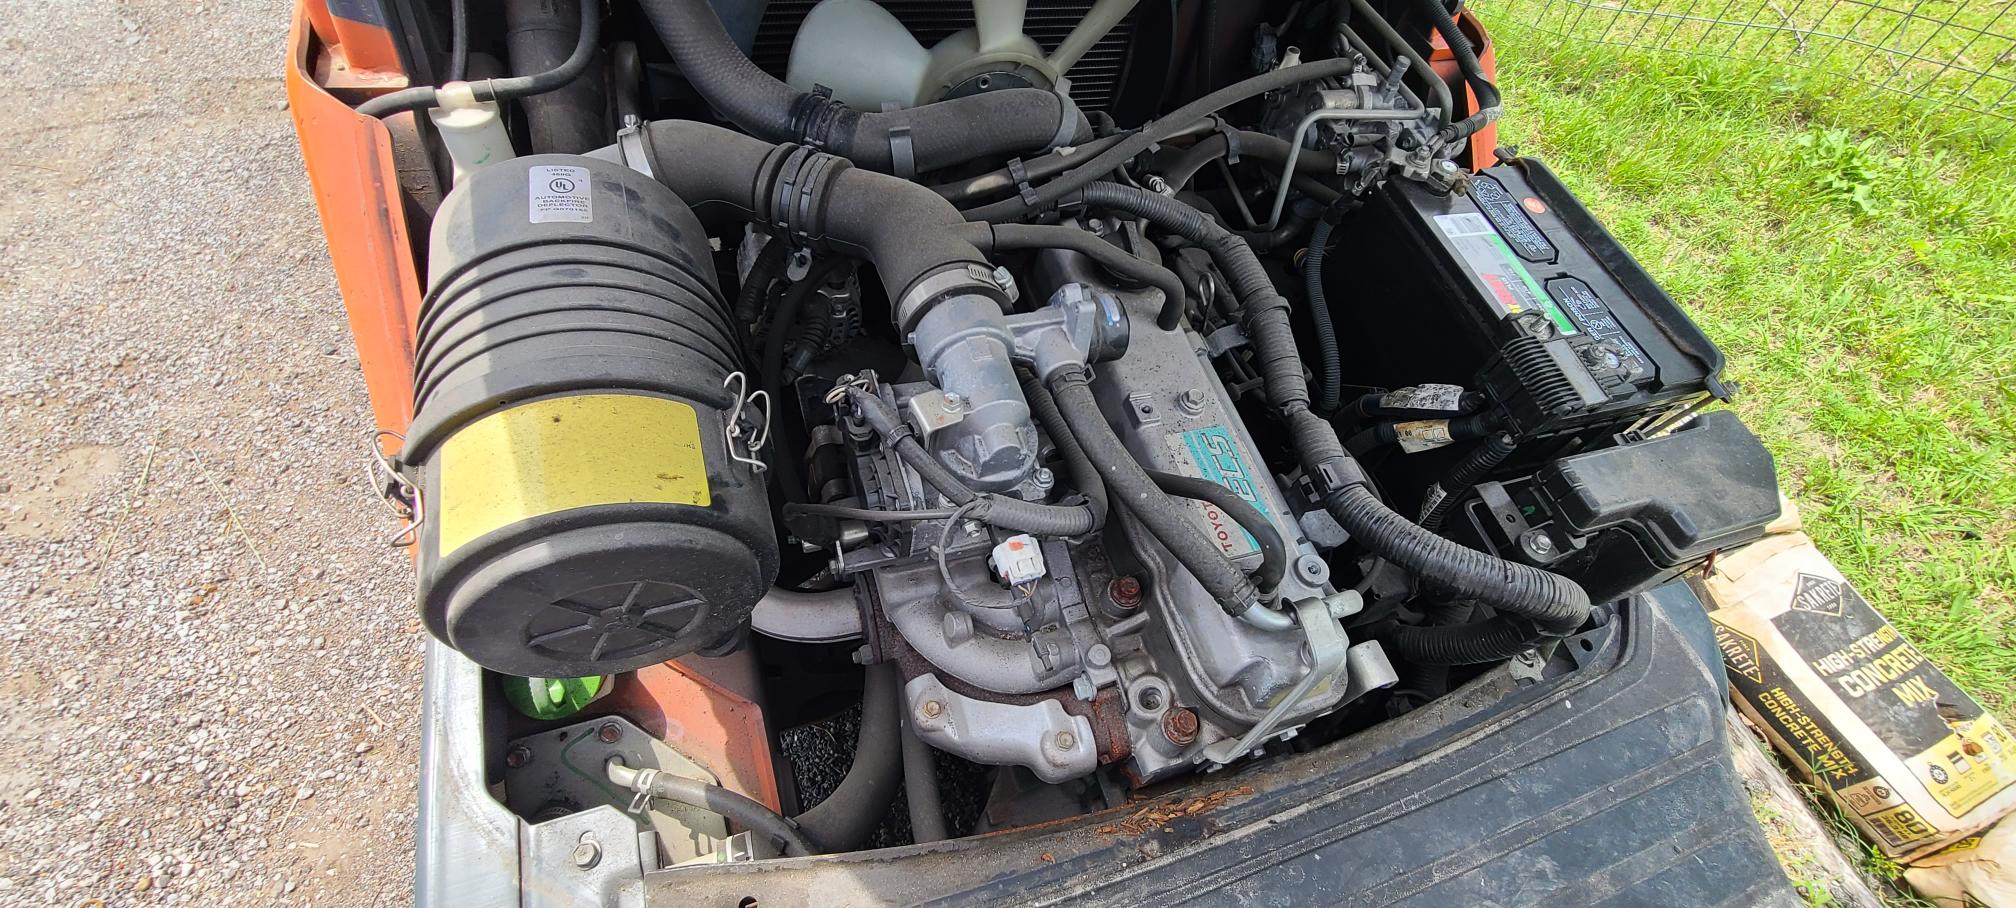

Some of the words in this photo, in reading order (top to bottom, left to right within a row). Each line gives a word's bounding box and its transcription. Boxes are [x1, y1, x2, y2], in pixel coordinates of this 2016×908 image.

[555, 181, 569, 190] UL
[1563, 298, 1584, 321] POISON
[1200, 433, 1257, 502] ECS
[1202, 502, 1233, 552] TOYOT
[1798, 580, 1841, 610] SAKRETE
[1715, 625, 1759, 677] SAKRETE
[1838, 643, 1923, 698] CONCRETE
[1892, 675, 1937, 707] MIX
[1758, 692, 1822, 752] CONCRETE
[1817, 752, 1847, 779] MIX
[1770, 687, 1858, 774] HIGH-STRENGTH
[1894, 810, 1928, 834] 80
